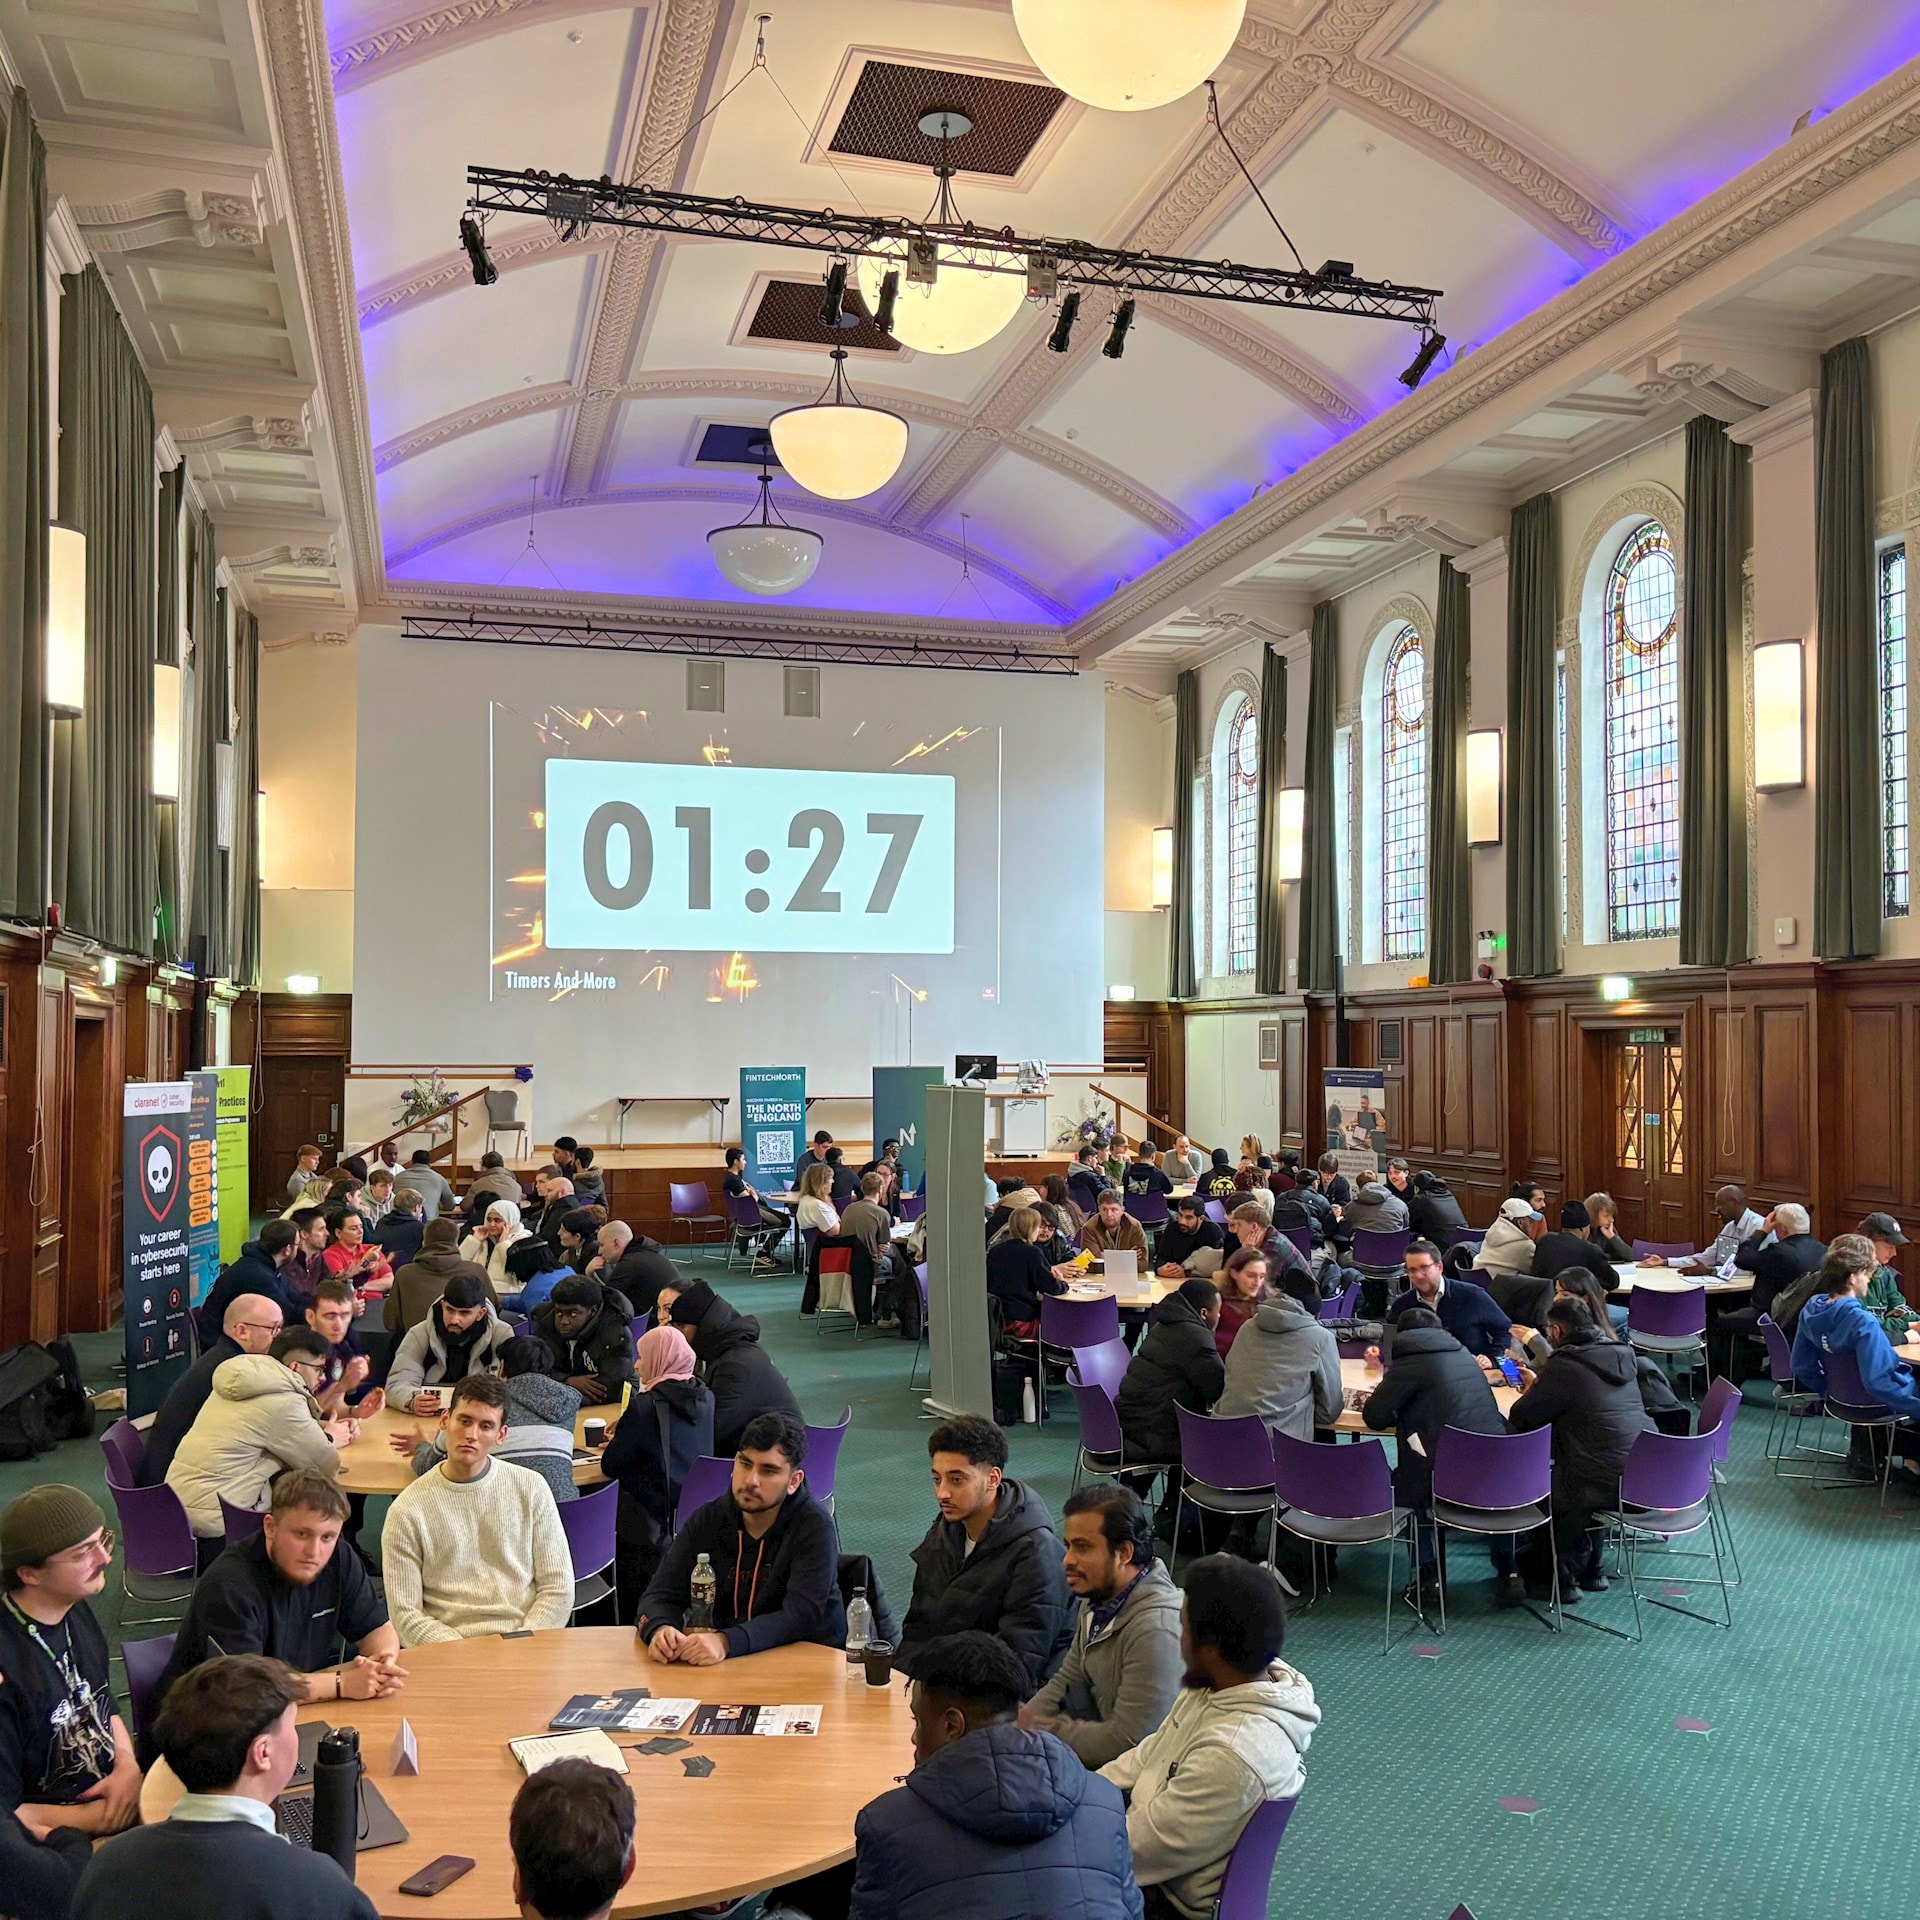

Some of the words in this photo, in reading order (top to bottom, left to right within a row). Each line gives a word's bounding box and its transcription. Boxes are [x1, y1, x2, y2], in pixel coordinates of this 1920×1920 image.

[583, 801, 924, 913] 01:27
[505, 971, 550, 989] Timers
[554, 970, 579, 989] And
[583, 972, 617, 989] More
[745, 1073, 801, 1082] FINTECHNORTH
[134, 1097, 160, 1108] claranet
[219, 1096, 246, 1107] Practices
[746, 1104, 765, 1114] THE
[767, 1103, 802, 1113] NORTH
[753, 1112, 802, 1122] ENGLAND
[139, 1233, 157, 1246] Your
[157, 1229, 181, 1243] career
[131, 1252, 139, 1265] in
[140, 1242, 189, 1265] cybersecurity
[140, 1265, 162, 1281] starts
[163, 1263, 181, 1276] here
